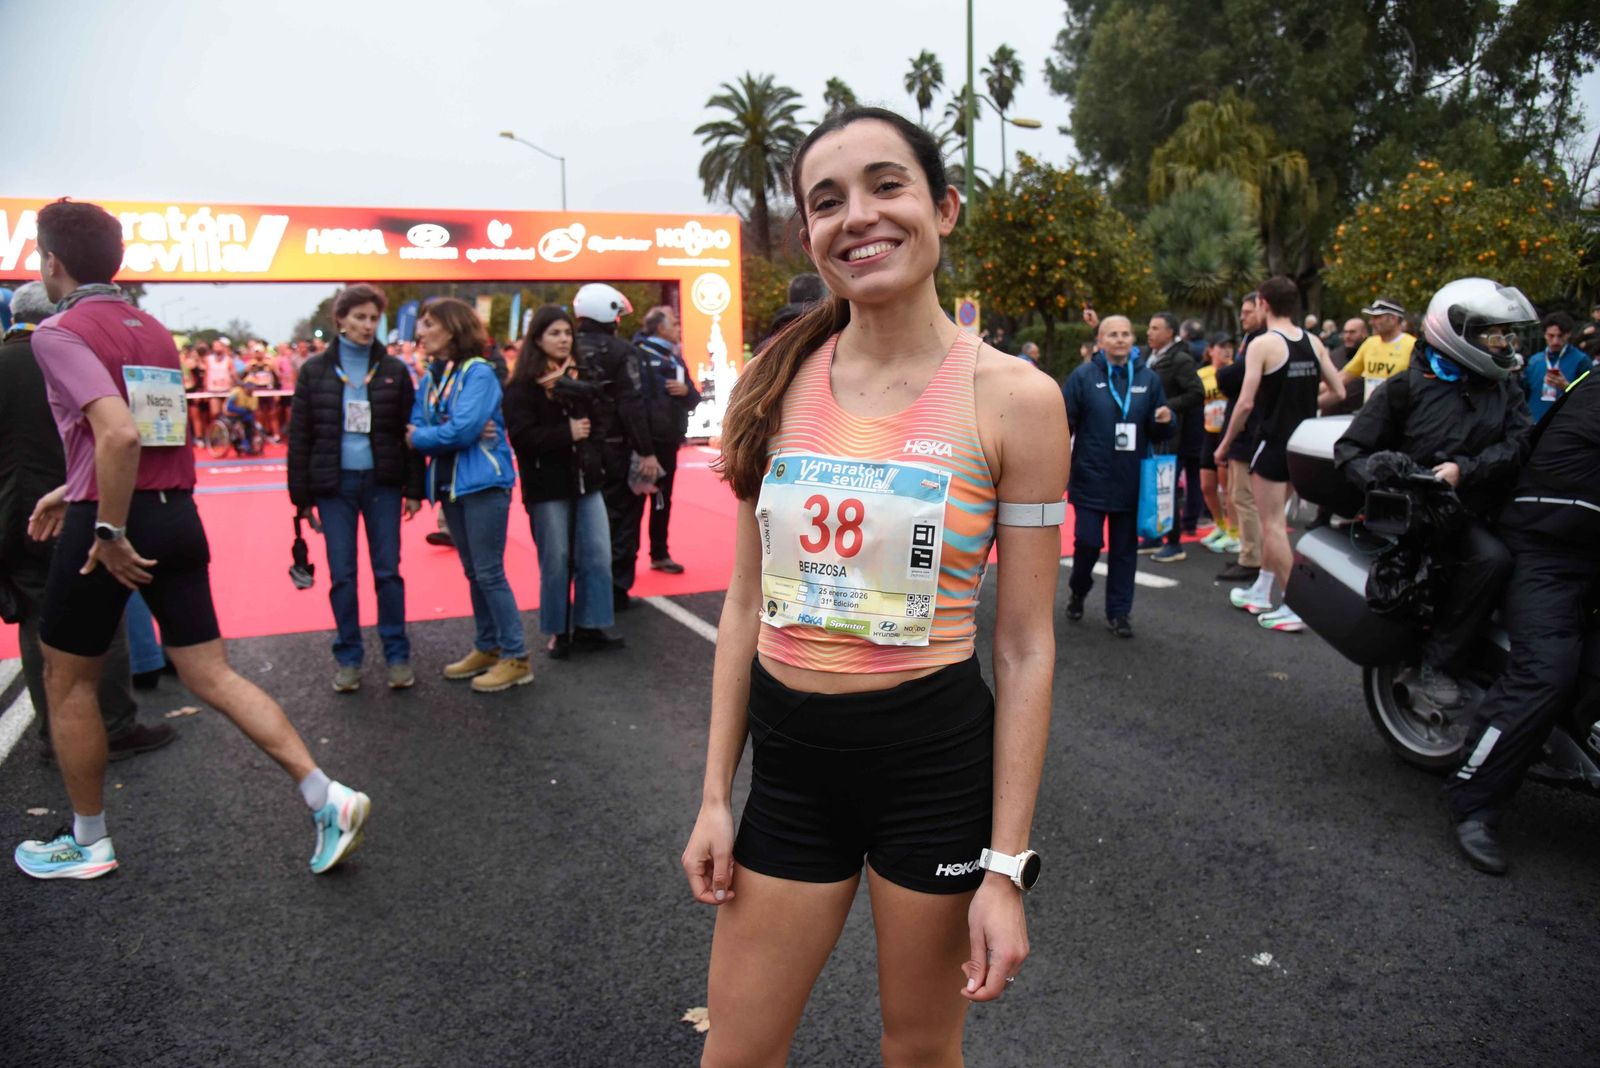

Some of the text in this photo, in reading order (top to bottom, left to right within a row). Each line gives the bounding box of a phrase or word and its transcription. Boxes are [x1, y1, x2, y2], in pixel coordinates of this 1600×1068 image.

[118, 206, 246, 242] ratón
[305, 228, 389, 254] HOKA
[119, 236, 255, 273] evilla
[1368, 362, 1395, 374] UPV
[902, 439, 952, 457] HOKA
[818, 461, 884, 478] maratón
[831, 474, 882, 490] sevilla
[799, 494, 865, 559] 38
[799, 560, 847, 578] BERZOSA
[818, 587, 869, 600] 25 enero 2026
[797, 612, 823, 626] HOKA
[830, 619, 866, 632] Sprinter
[935, 859, 980, 876] HOKA
